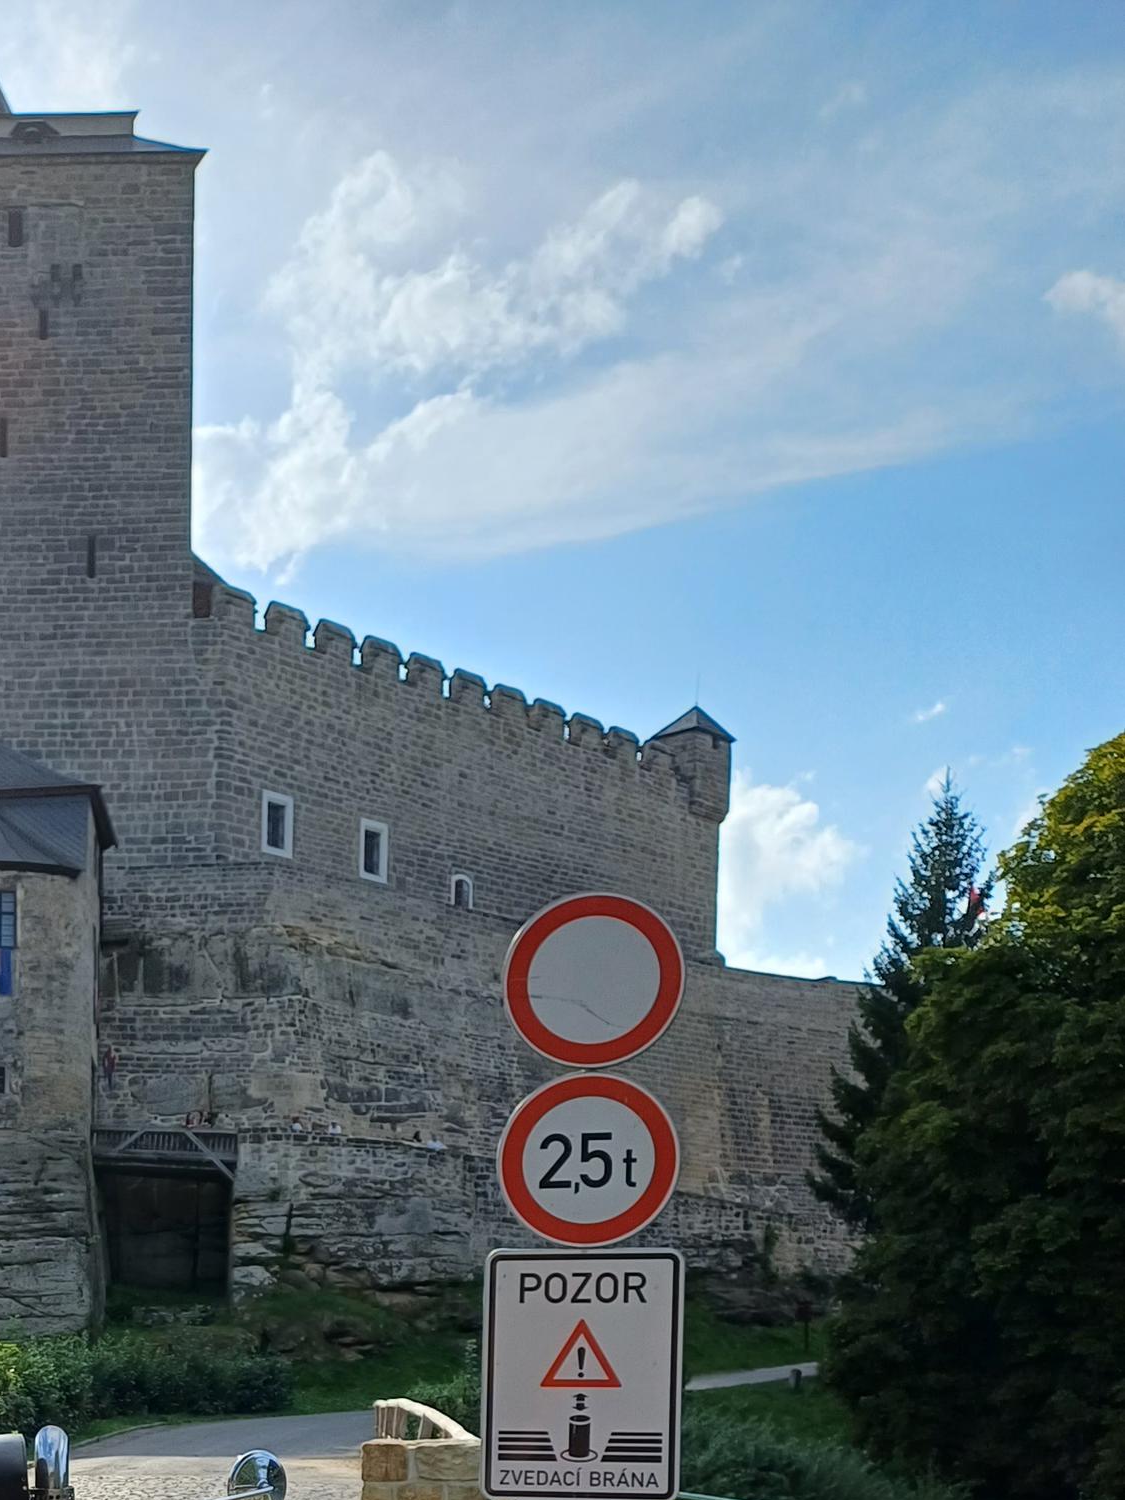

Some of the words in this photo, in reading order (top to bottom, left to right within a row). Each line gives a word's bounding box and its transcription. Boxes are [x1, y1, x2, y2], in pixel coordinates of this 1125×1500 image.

[538, 1131, 613, 1195] 2,5
[622, 1148, 638, 1188] t
[519, 1272, 647, 1304] POZOR
[499, 1467, 581, 1487] ZVEDACÍ
[589, 1467, 660, 1488] BRÁNA
